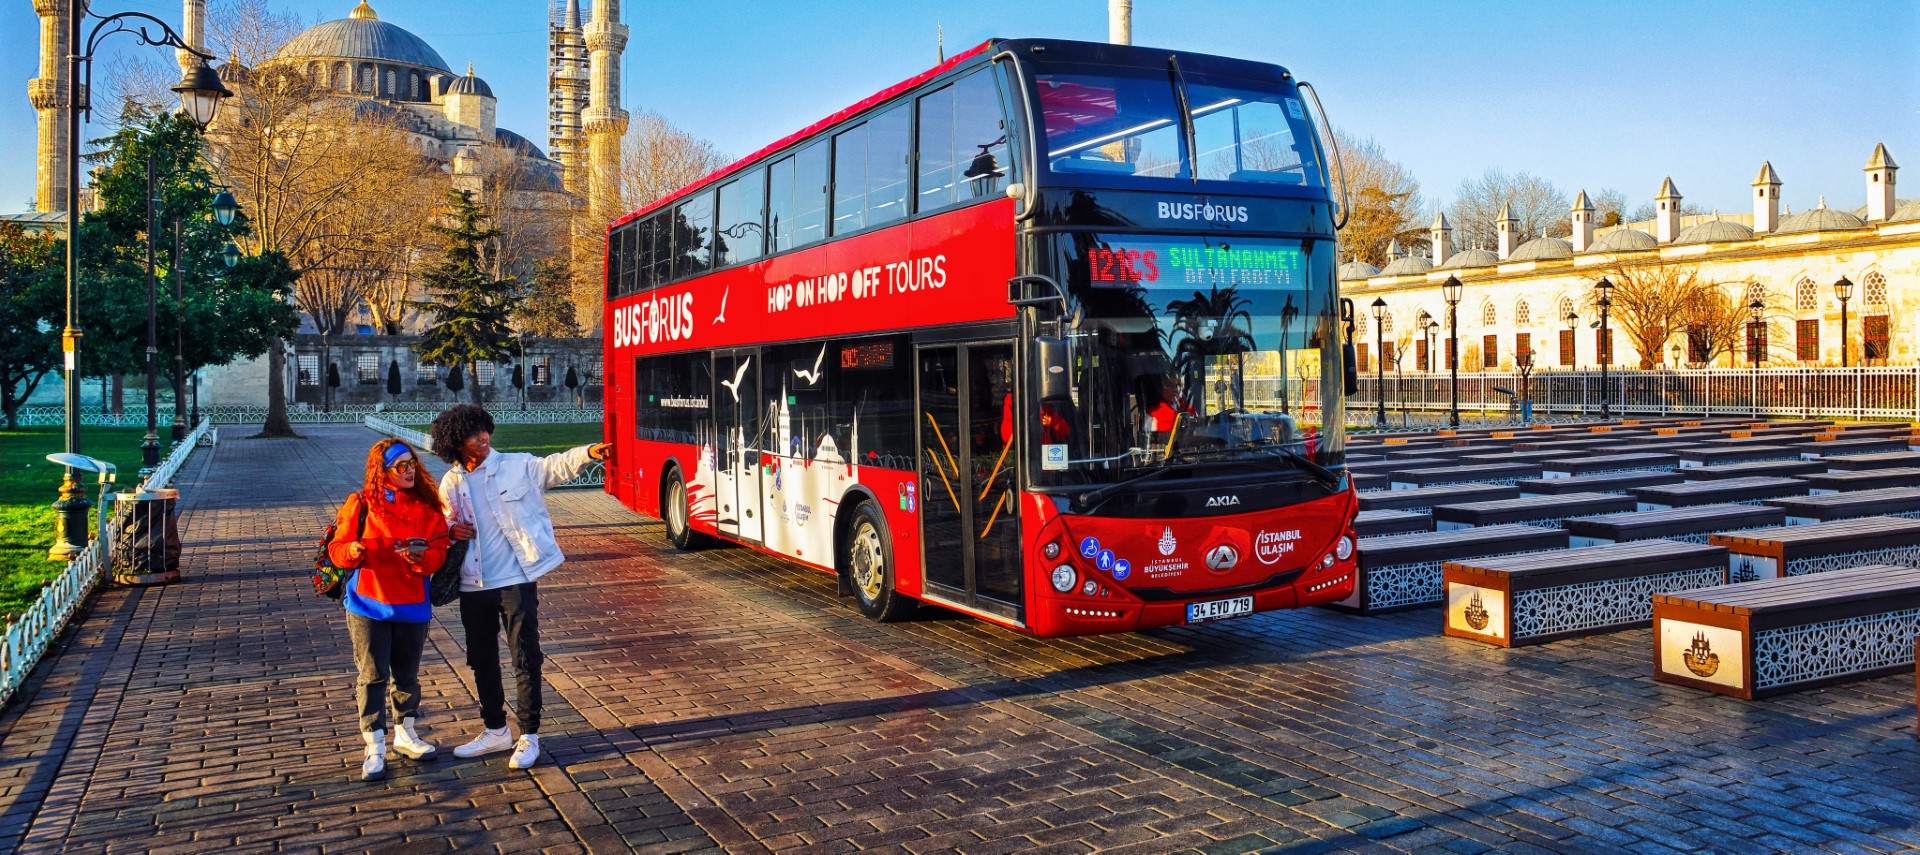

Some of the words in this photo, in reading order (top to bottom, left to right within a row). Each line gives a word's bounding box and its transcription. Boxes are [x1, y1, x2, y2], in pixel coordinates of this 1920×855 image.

[1158, 200, 1248, 222] BUSFORUS
[1088, 248, 1159, 283] 121CS
[1169, 247, 1298, 270] SULTANAHMET
[768, 283, 793, 313] HOP
[796, 279, 814, 308] ON
[818, 272, 848, 304] HOP
[852, 266, 881, 299] OFF
[886, 254, 947, 295] TOURS
[614, 291, 693, 348] BUSFORUS
[1205, 495, 1240, 507] AKIA
[1193, 604, 1206, 618] 34
[1210, 600, 1229, 616] EVD
[1233, 598, 1250, 612] 719
